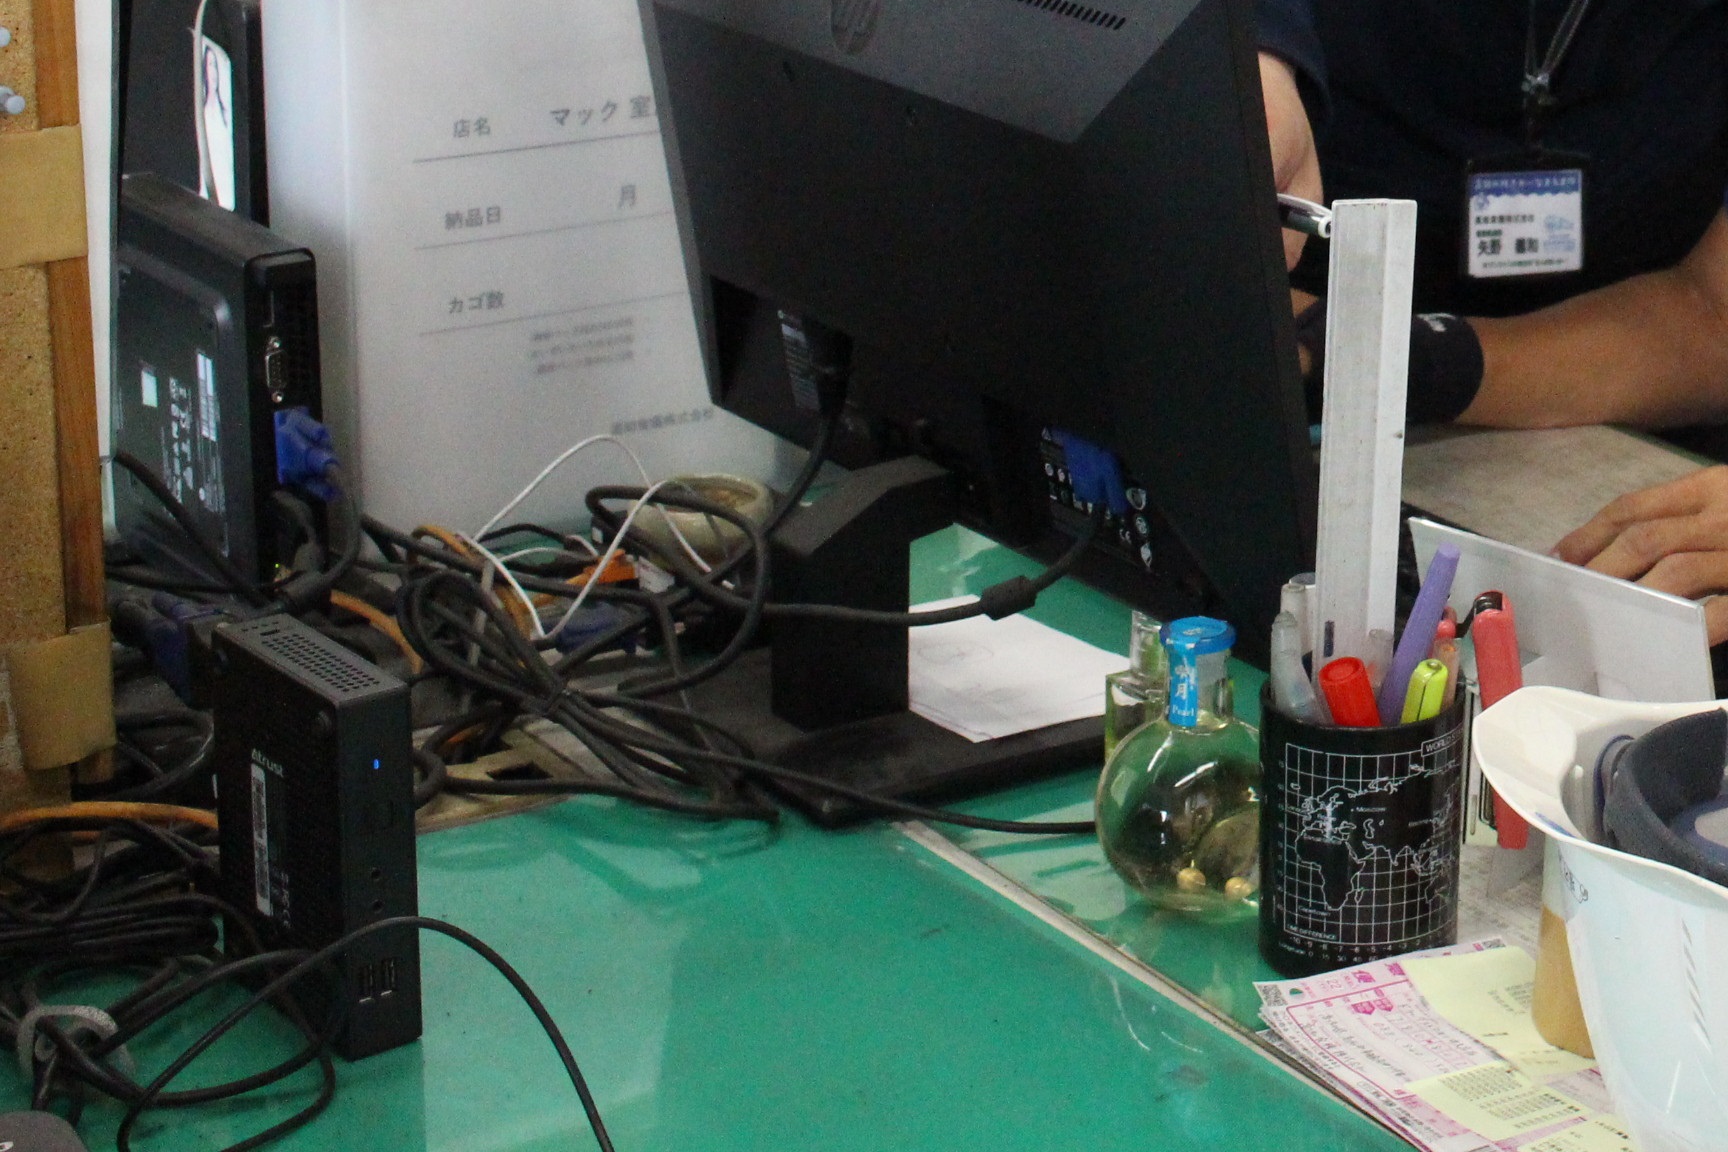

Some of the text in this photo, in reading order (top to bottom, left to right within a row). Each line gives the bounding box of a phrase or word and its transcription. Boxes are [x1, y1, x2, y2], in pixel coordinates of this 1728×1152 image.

[453, 116, 491, 138] 店名
[444, 184, 637, 230] 納品日 月
[449, 291, 505, 314] カゴ数
